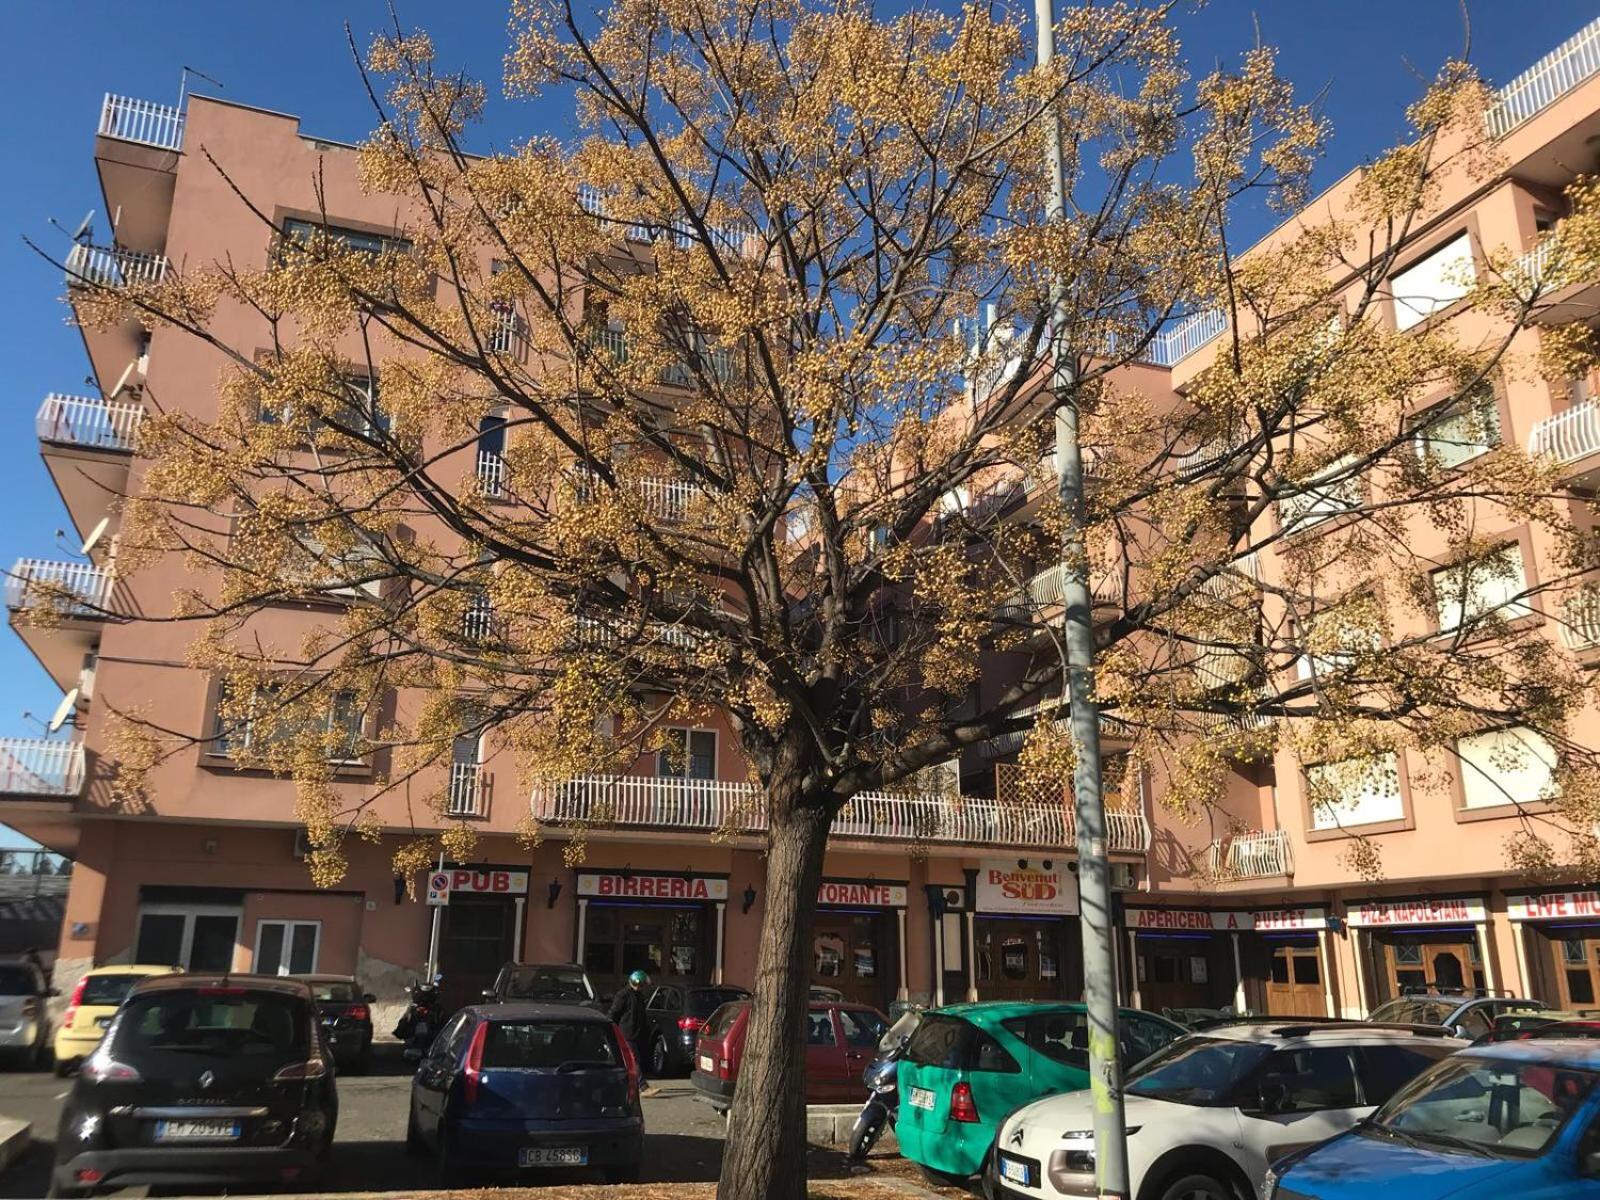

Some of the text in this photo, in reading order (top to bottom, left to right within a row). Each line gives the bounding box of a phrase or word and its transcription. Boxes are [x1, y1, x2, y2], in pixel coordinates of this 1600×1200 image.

[452, 869, 510, 891] PUB
[598, 876, 709, 898] BIRRERIA
[1360, 899, 1469, 924] PIZZA NAPOLETANA
[1525, 894, 1567, 916] LIVE
[1138, 909, 1306, 929] APERICENA A BUFFET
